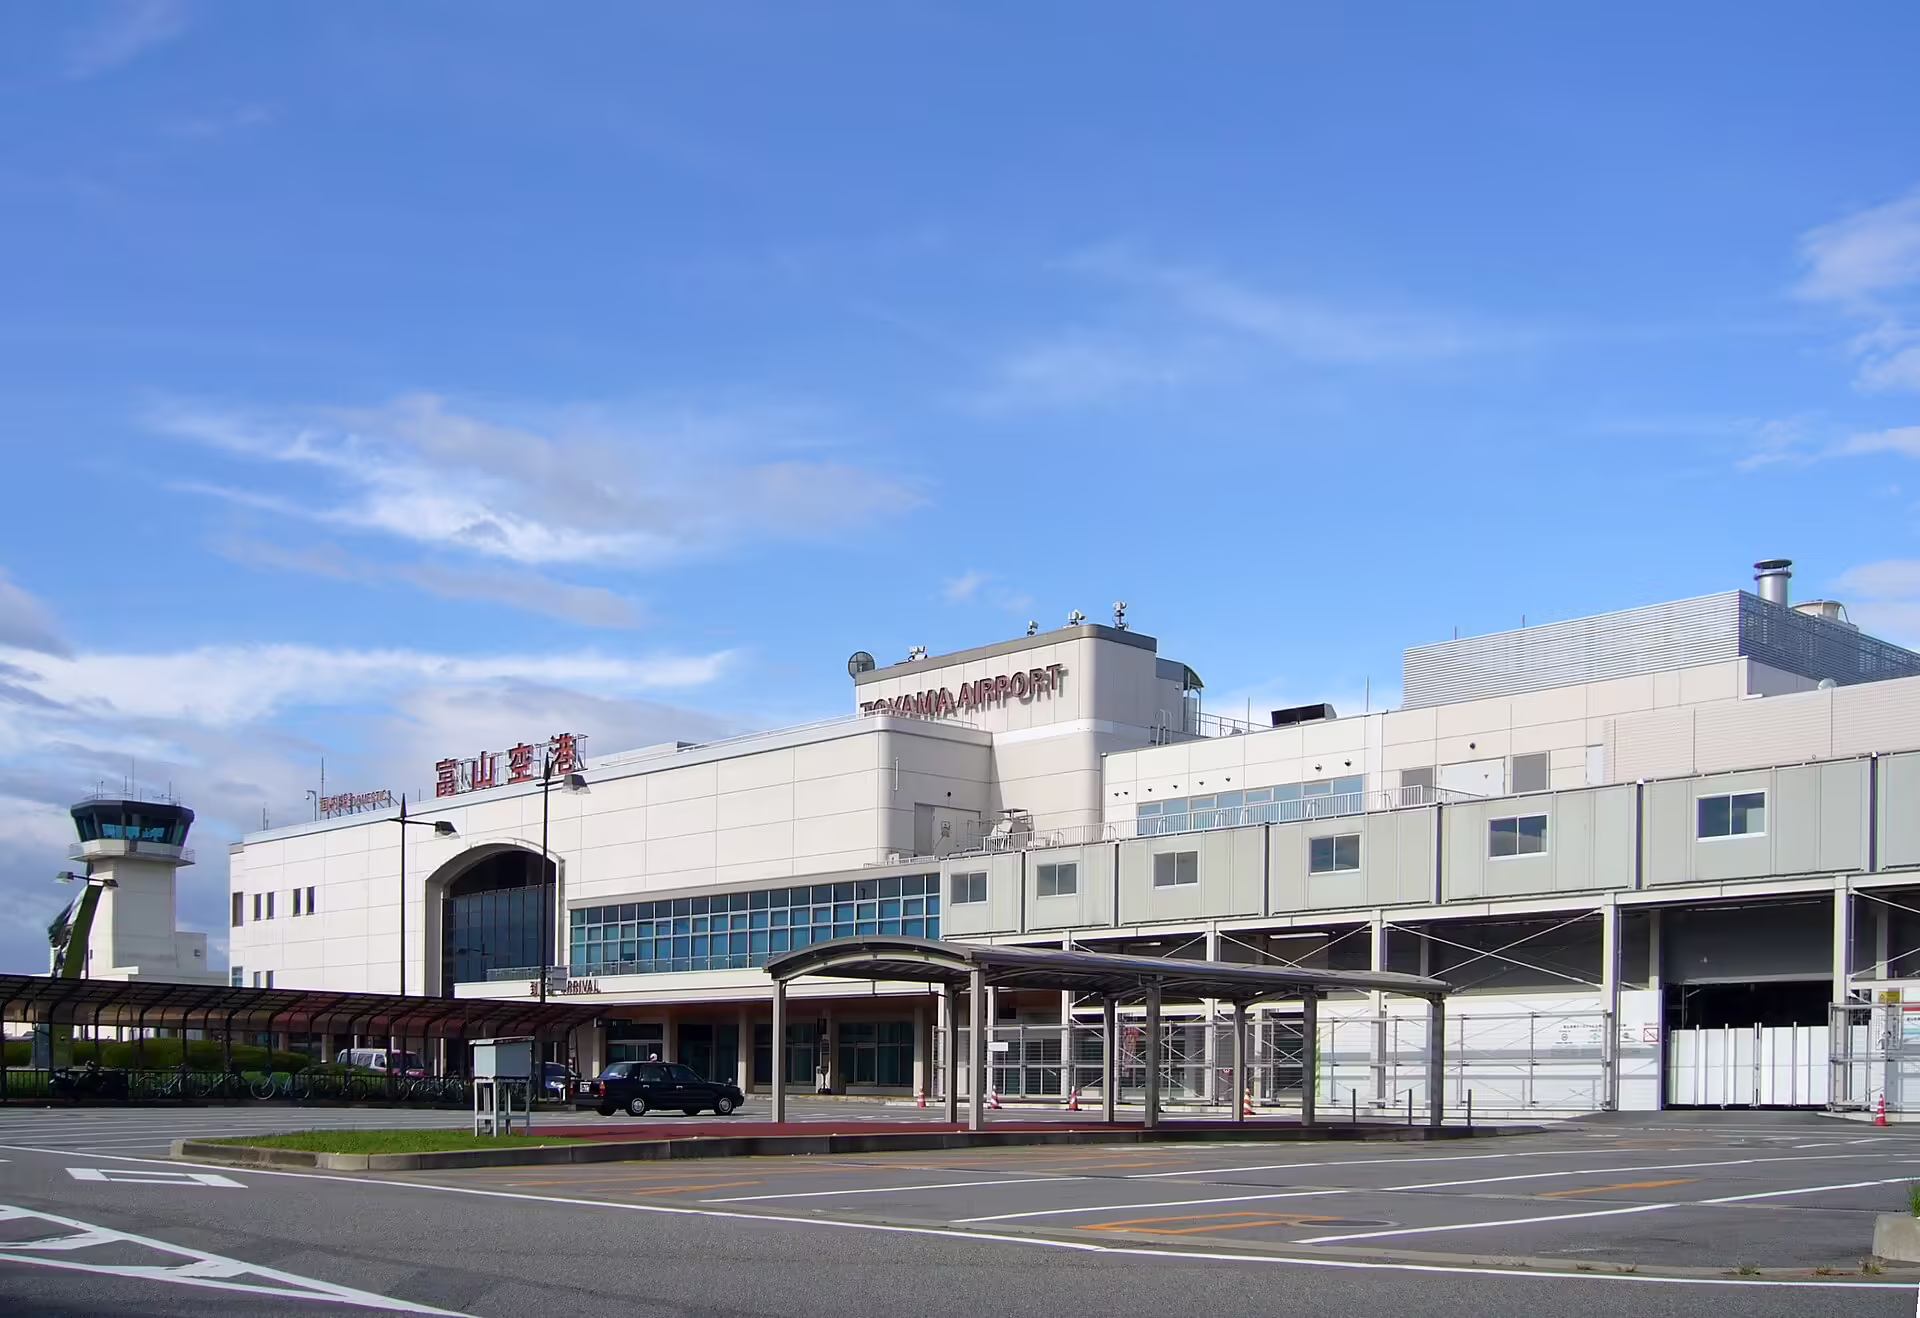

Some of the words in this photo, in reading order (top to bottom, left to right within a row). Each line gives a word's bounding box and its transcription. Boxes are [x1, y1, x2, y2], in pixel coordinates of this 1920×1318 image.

[860, 687, 953, 718] TOYAMA
[957, 663, 1064, 708] AIRPORT
[436, 733, 576, 798] 富山空港
[566, 979, 601, 994] RRIVAL
